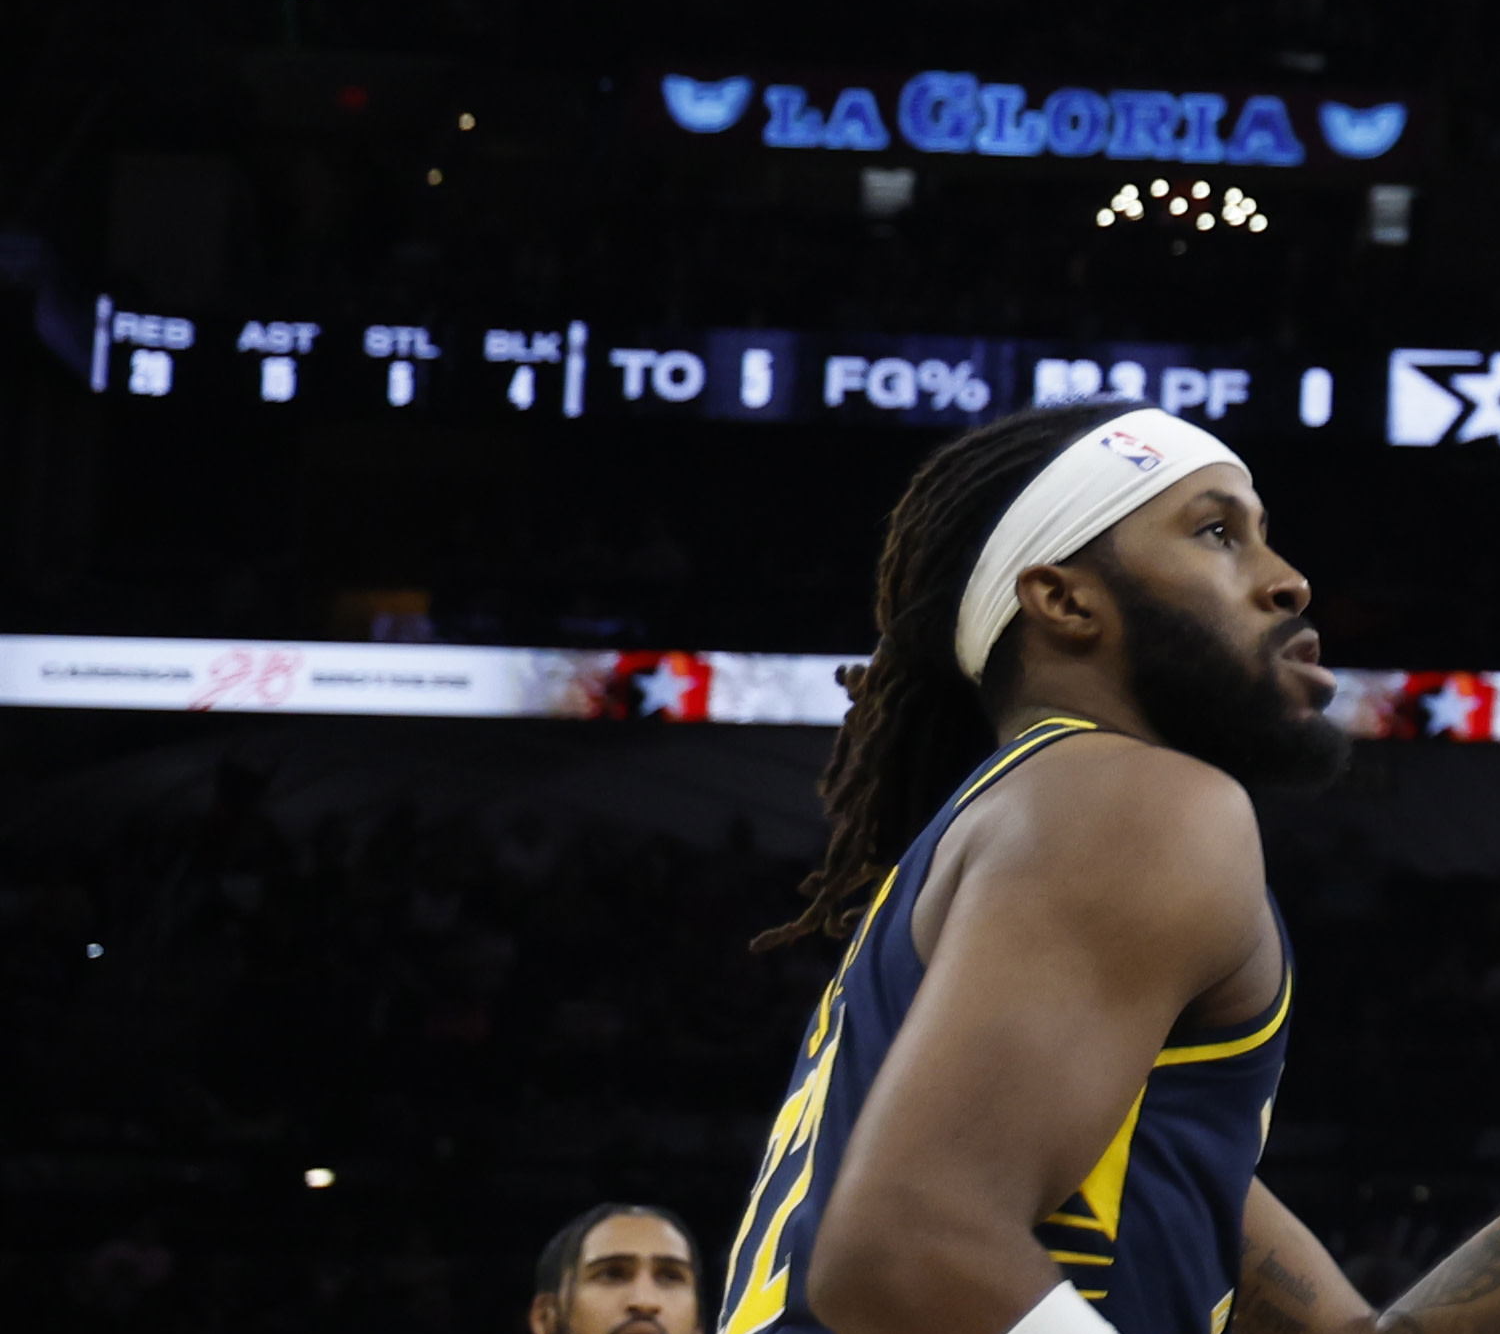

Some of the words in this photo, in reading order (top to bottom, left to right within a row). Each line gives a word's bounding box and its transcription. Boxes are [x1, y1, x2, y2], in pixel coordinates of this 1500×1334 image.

[611, 347, 704, 403] TO
[824, 355, 990, 413] FG%
[1161, 369, 1249, 419] PF
